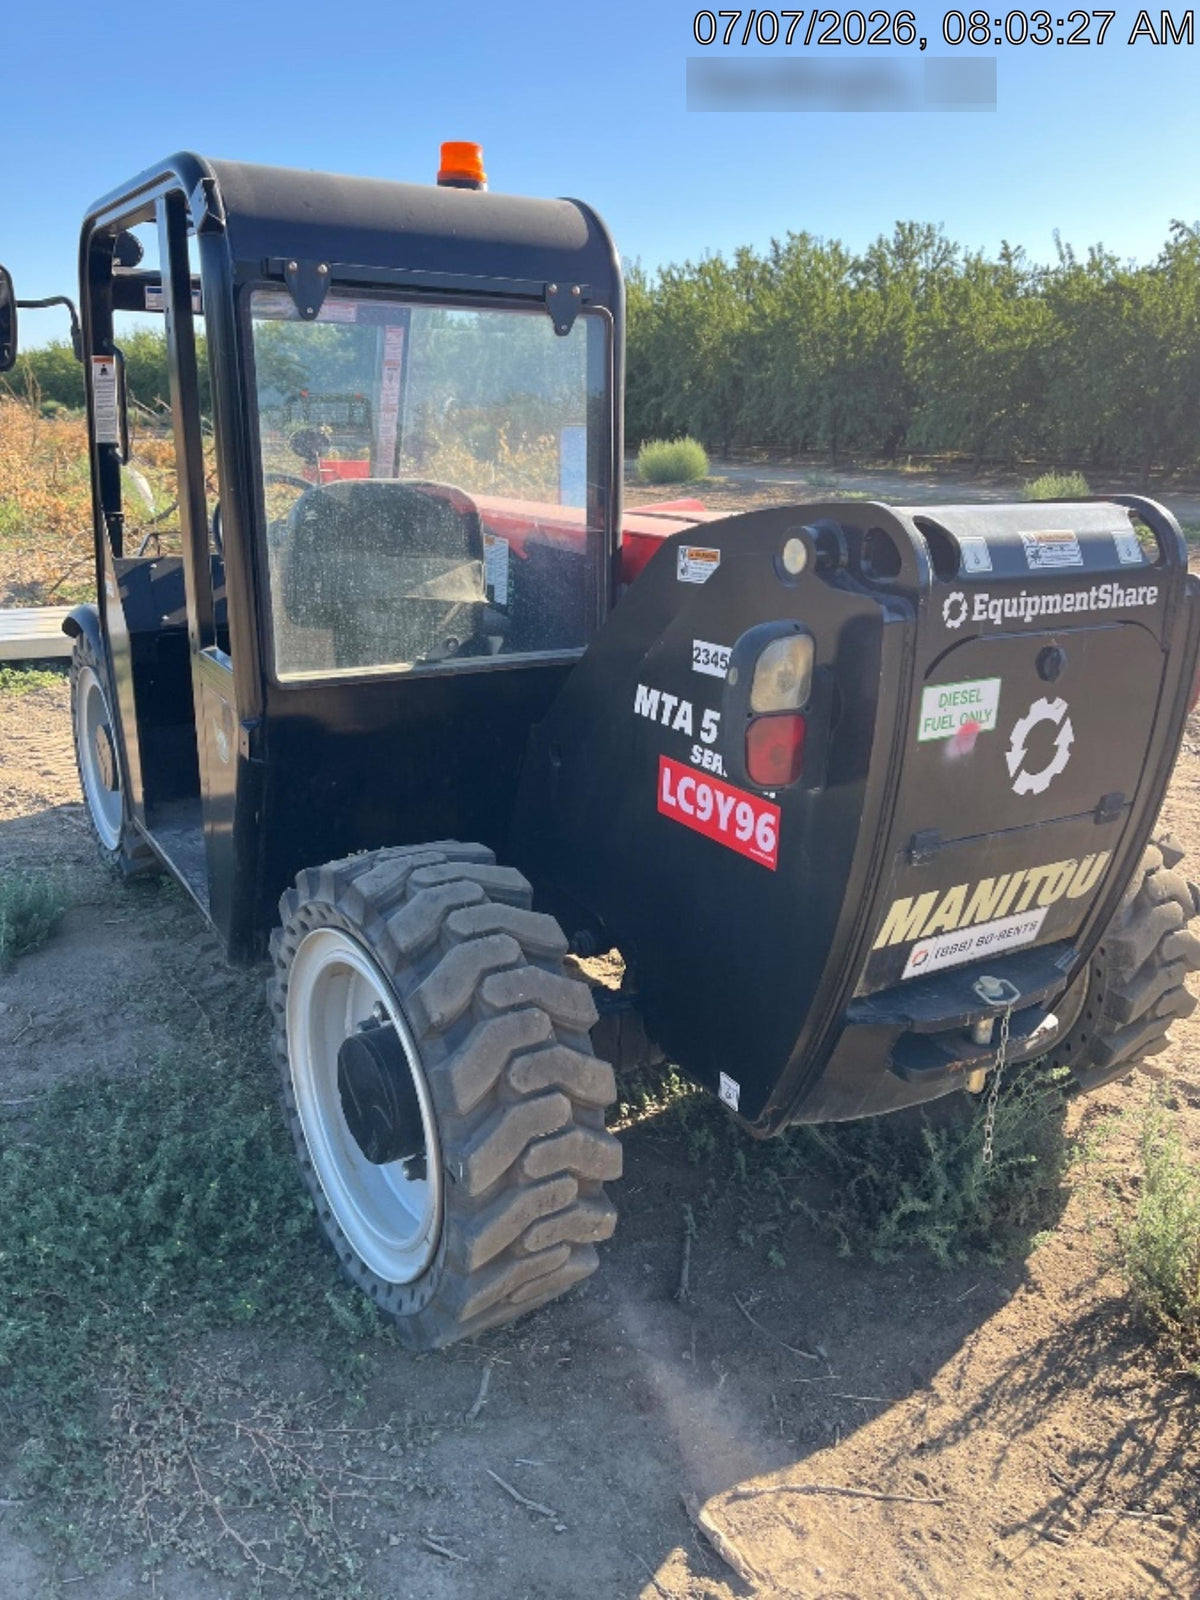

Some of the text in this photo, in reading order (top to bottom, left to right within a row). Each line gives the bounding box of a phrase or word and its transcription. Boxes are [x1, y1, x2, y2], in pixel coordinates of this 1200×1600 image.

[972, 583, 1158, 624] EquipmentShare
[634, 684, 693, 736] MTA
[938, 688, 983, 708] DIESEL
[924, 709, 993, 732] FUEL ONLY
[662, 767, 776, 853] LC9Y96
[873, 850, 1112, 950] MANITOU
[934, 939, 973, 959] (888)
